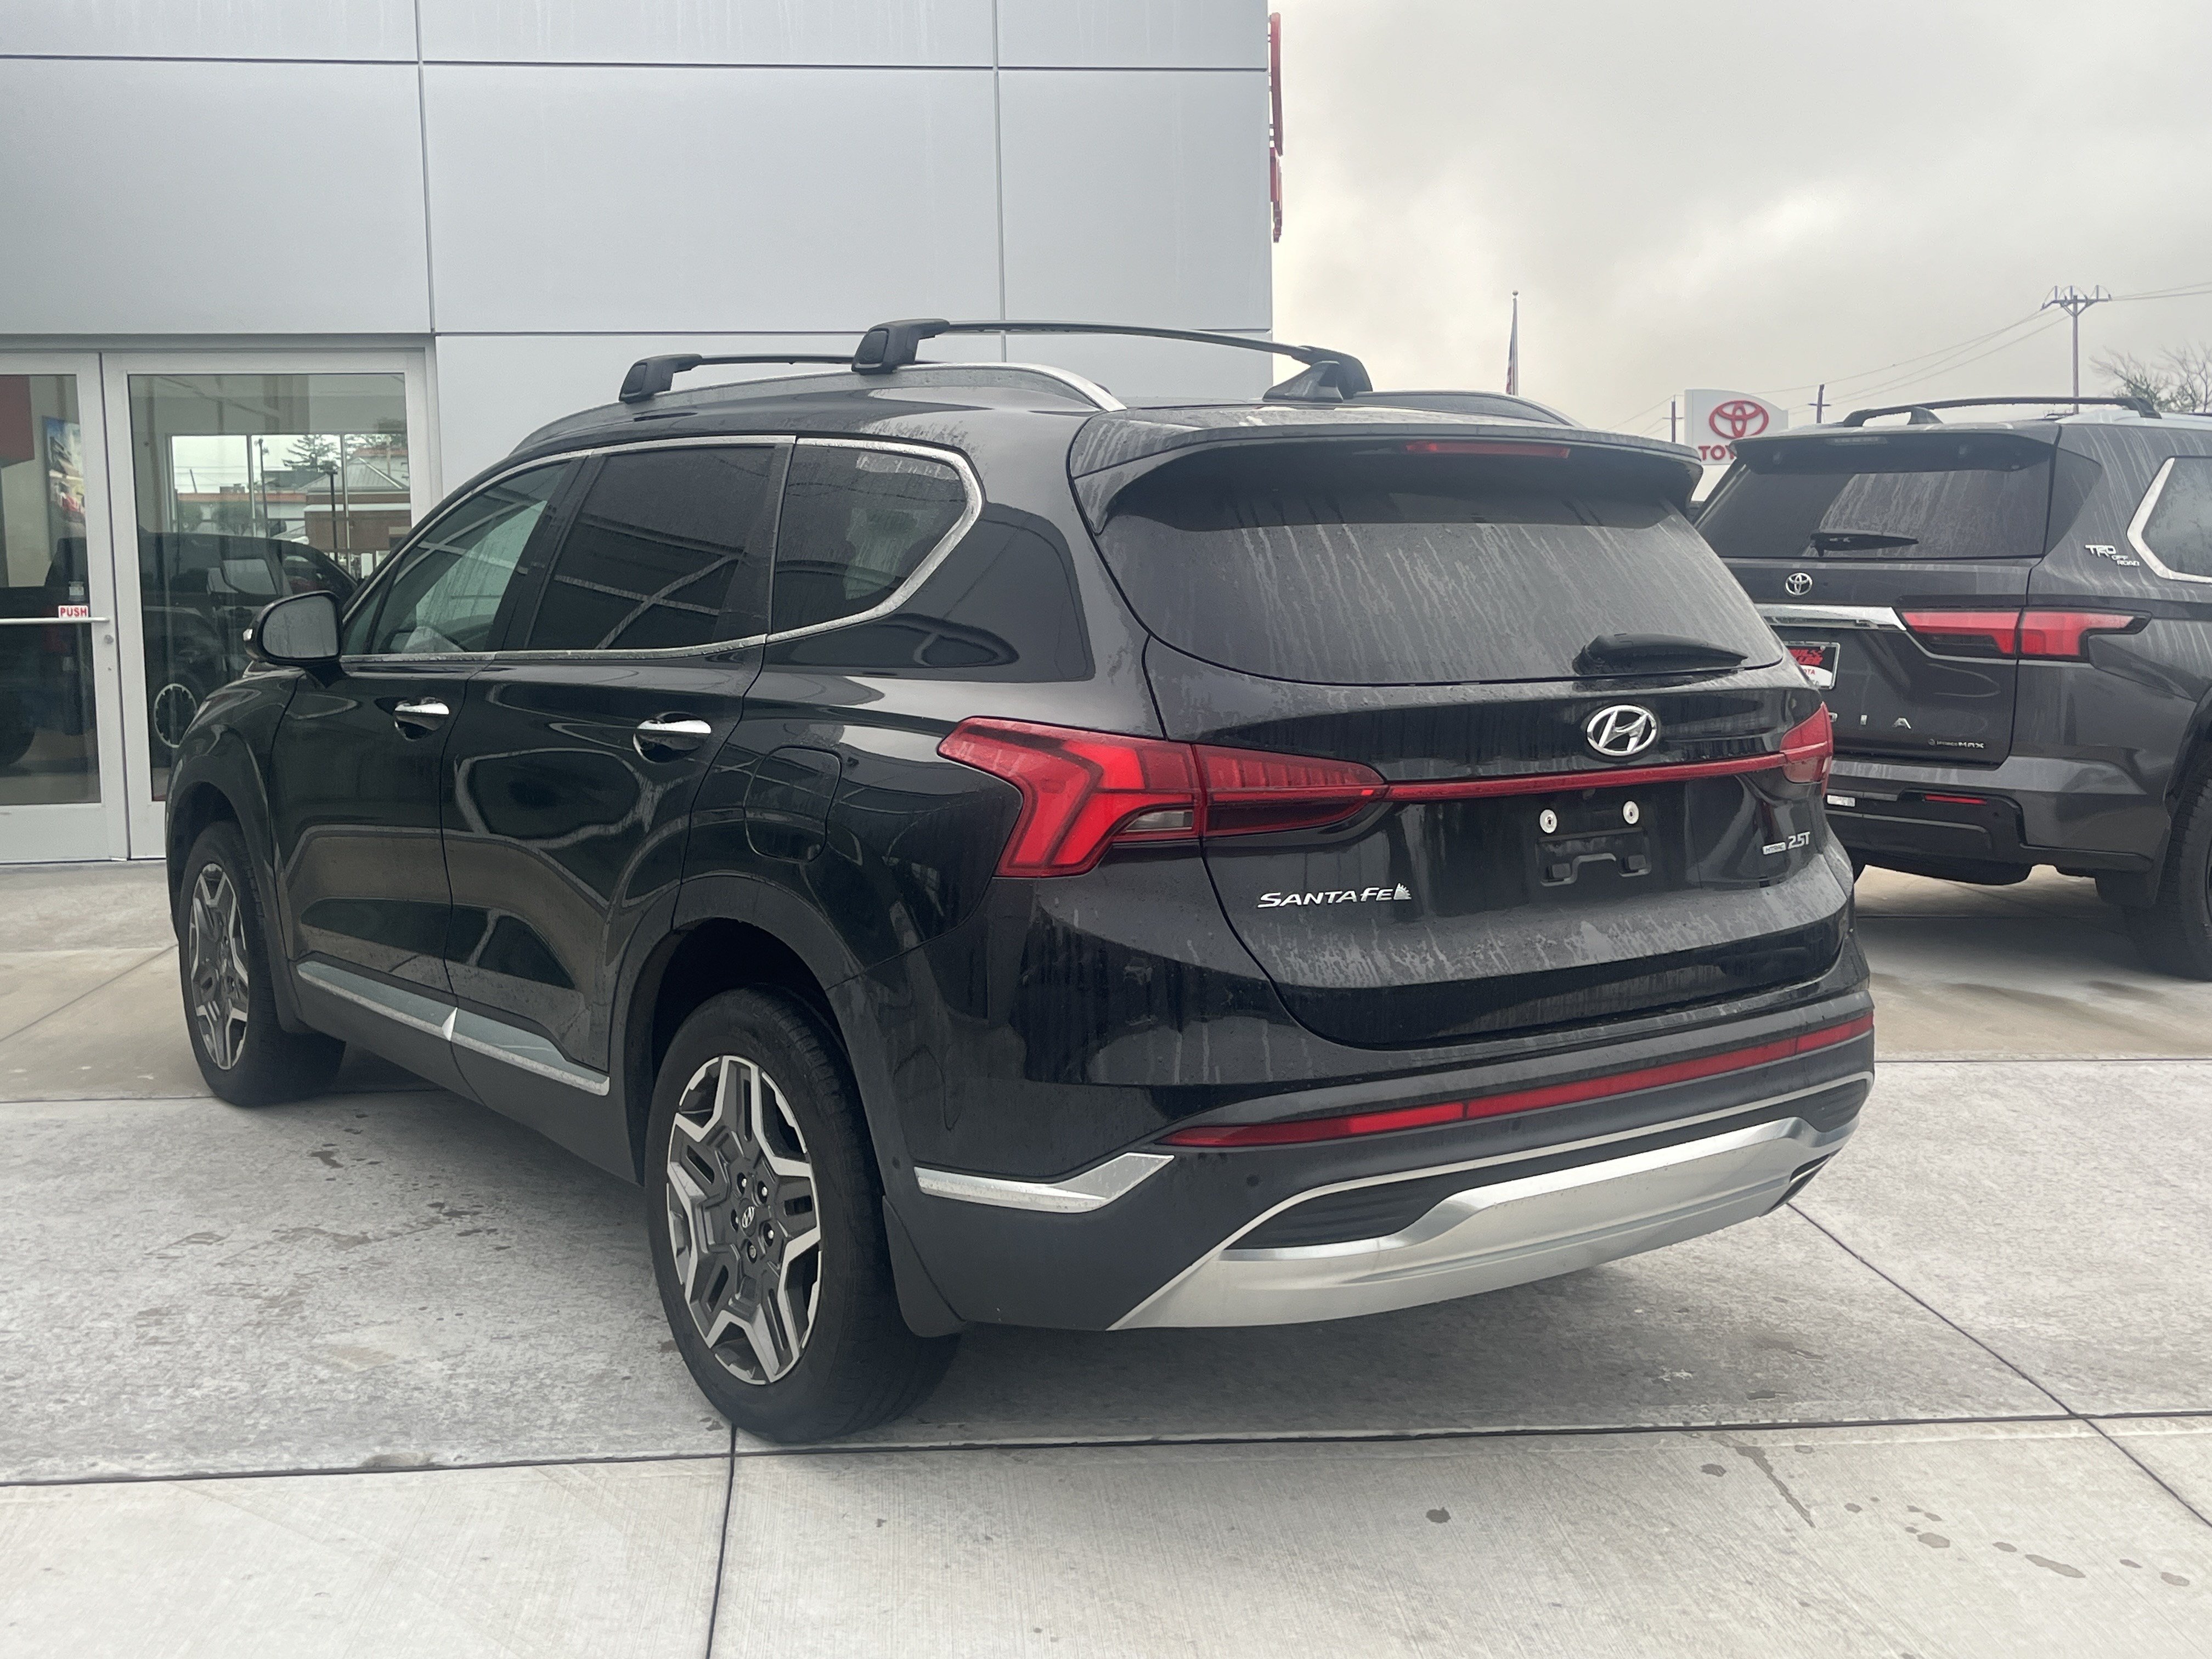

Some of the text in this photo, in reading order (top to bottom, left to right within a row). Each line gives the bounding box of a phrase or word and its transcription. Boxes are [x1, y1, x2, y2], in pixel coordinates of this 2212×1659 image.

[2085, 544, 2117, 557] TRD
[60, 607, 87, 617] PUSH
[1257, 890, 1357, 909] SANTA
